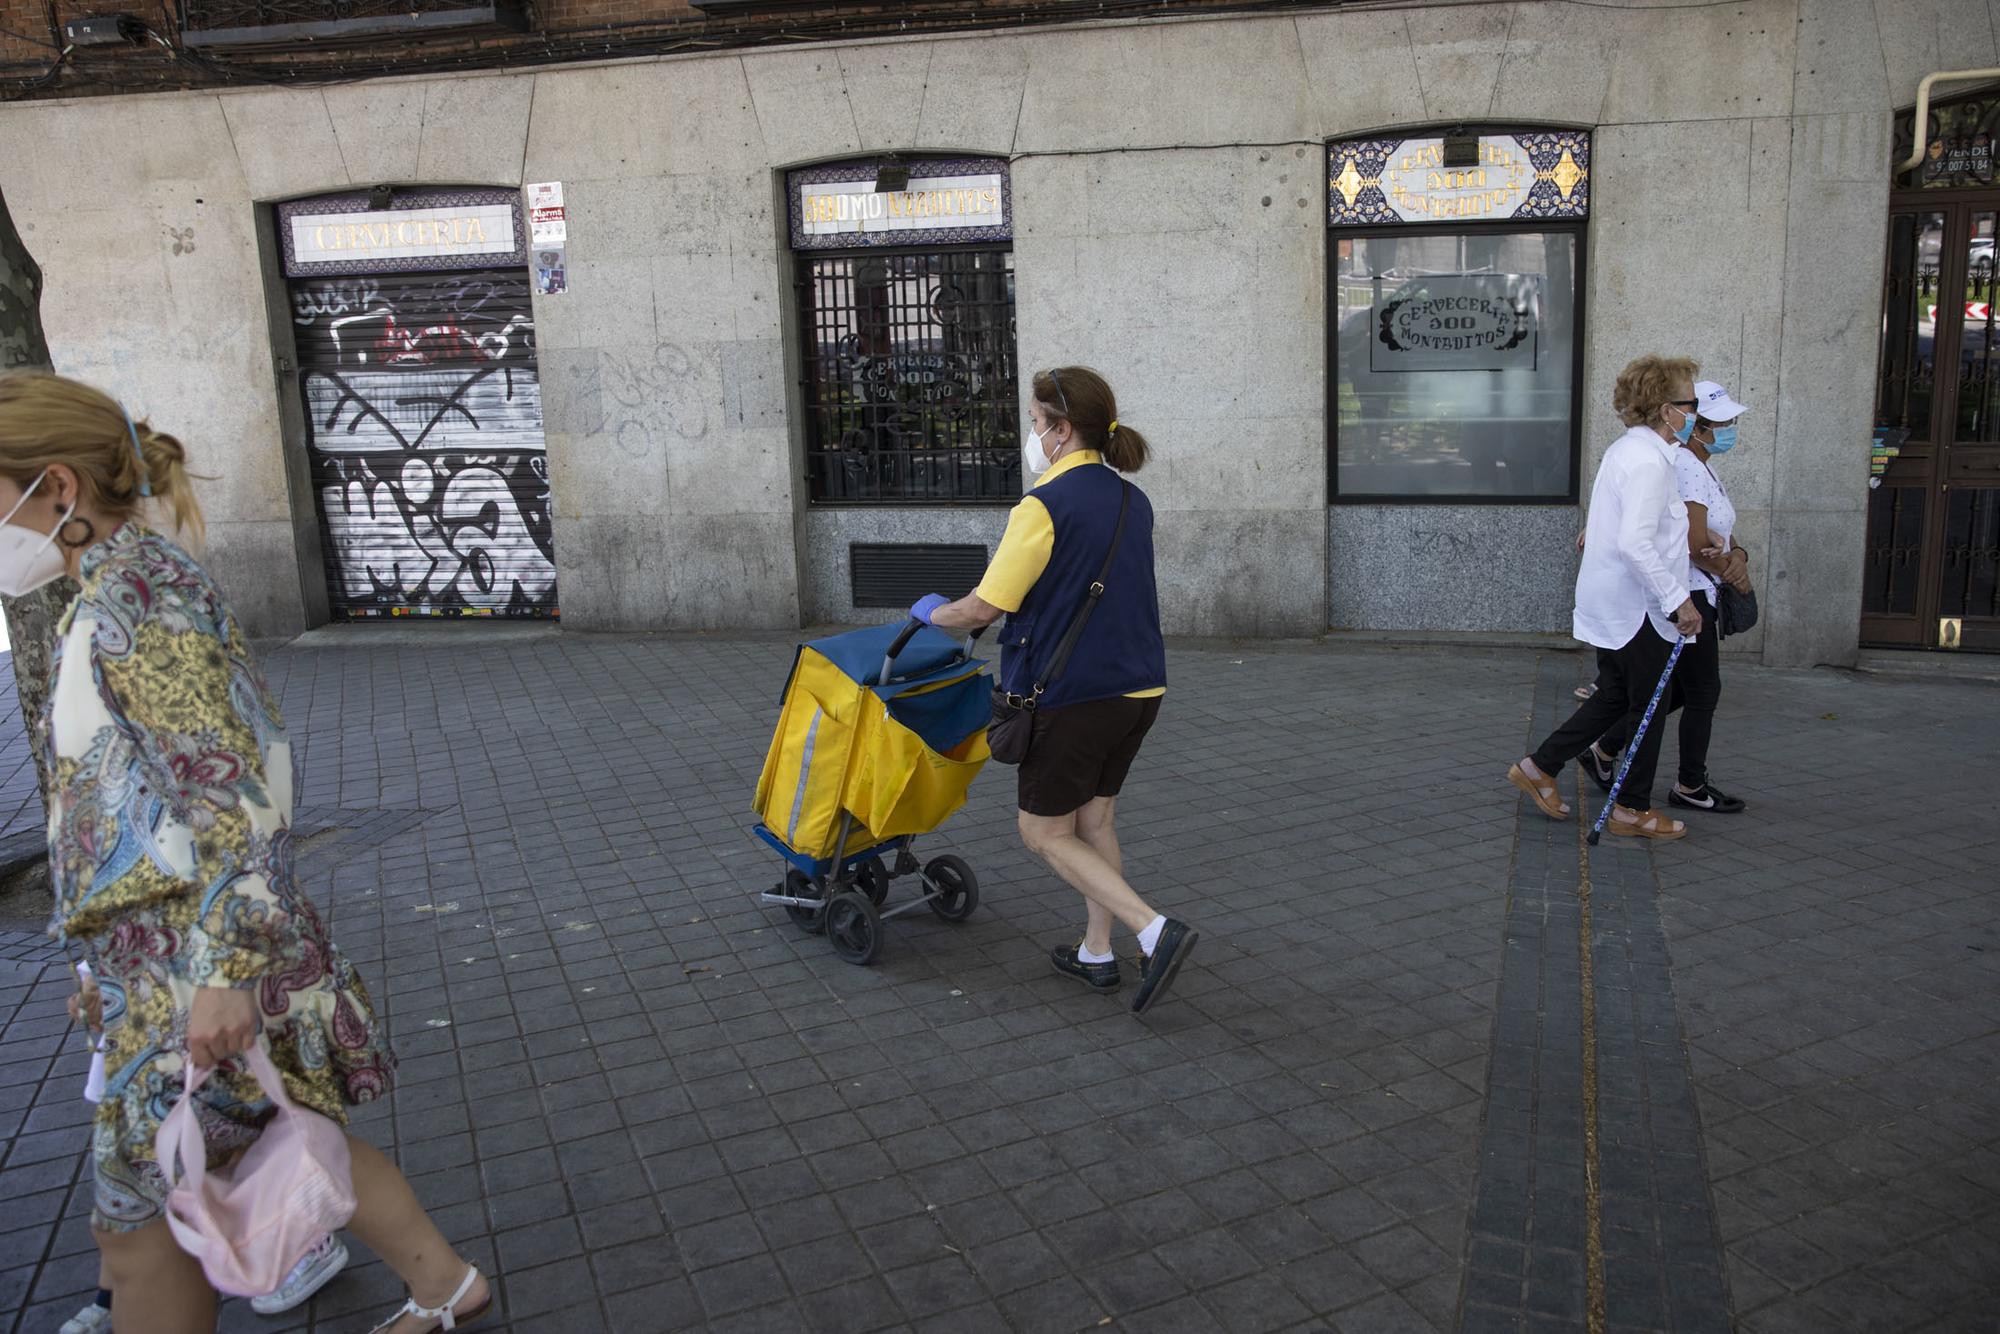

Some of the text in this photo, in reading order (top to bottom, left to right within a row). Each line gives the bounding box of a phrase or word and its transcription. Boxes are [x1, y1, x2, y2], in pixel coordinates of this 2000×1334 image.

[1389, 143, 1525, 182] CERVERIA
[532, 208, 562, 217] Alarma
[315, 217, 487, 253] CERVECERIA
[1400, 297, 1510, 327] CERVECERIA
[1401, 325, 1506, 351] MONTADITOS
